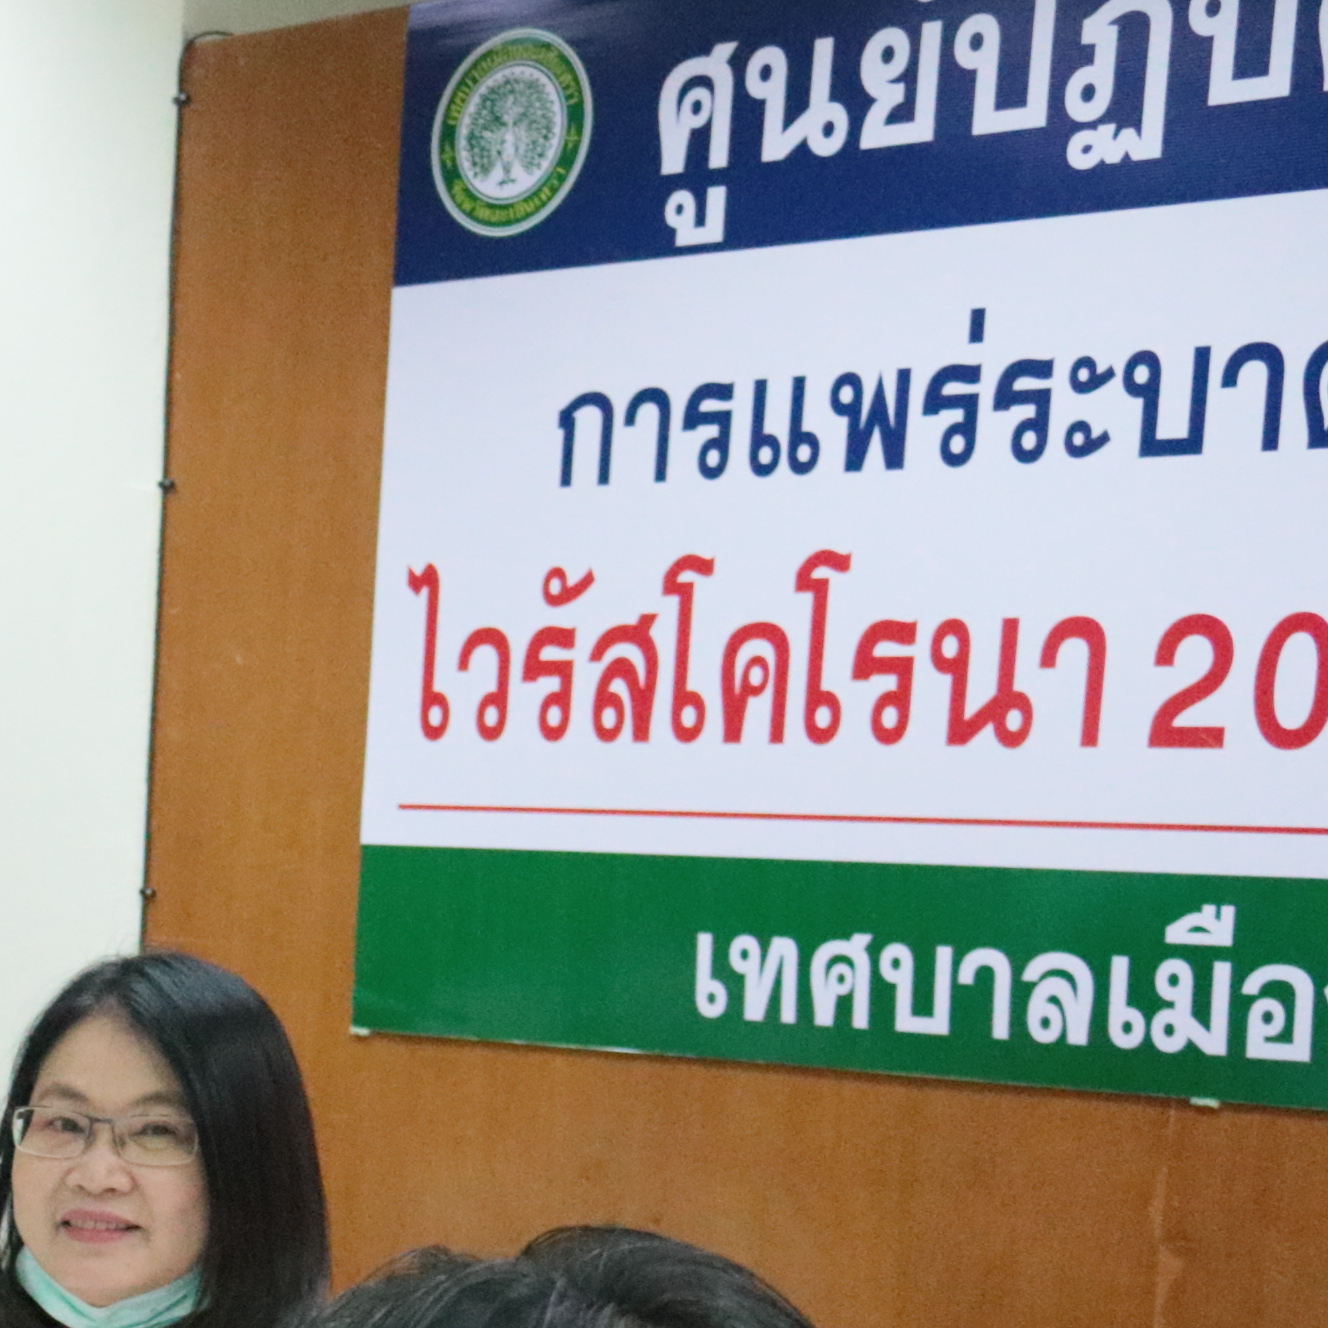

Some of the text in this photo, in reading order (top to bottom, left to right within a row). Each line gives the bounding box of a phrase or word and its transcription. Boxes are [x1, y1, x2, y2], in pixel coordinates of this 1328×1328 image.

[407, 549, 1108, 750] ไวรัสโคโรนา
[694, 903, 1328, 1063] เทศบาลเมือ
